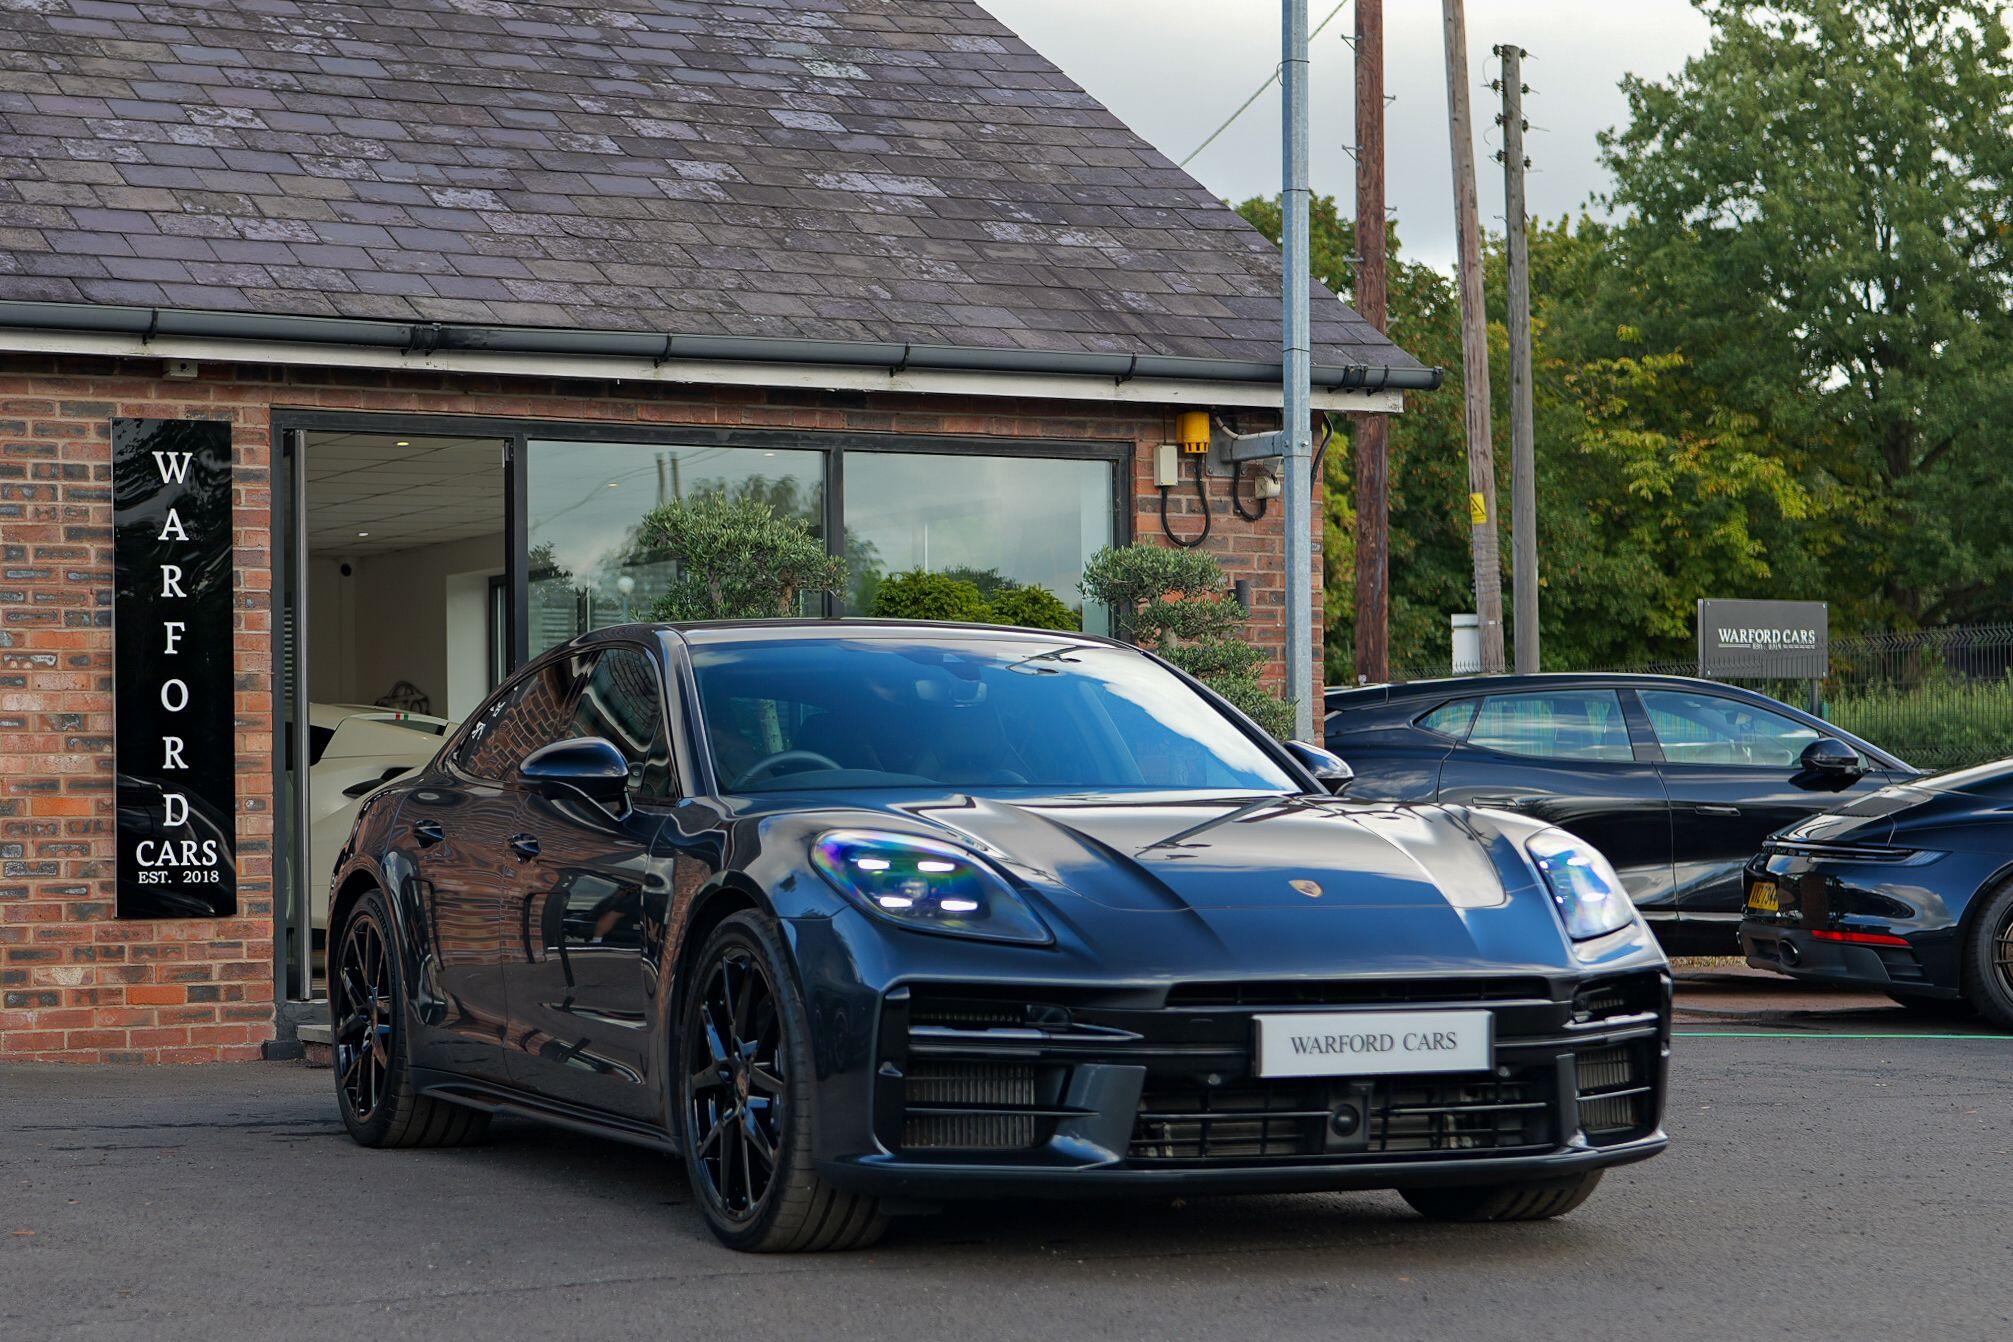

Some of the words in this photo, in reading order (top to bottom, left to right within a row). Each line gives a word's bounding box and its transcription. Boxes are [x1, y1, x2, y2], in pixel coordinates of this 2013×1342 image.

[151, 451, 193, 827] WARFORD
[1718, 628, 1781, 643] WARFORD
[1782, 629, 1816, 644] CARS
[136, 839, 218, 867] CARS
[138, 871, 172, 884] EST.
[182, 870, 220, 883] 2018
[1290, 1033, 1394, 1055] WARFORD
[1402, 1031, 1457, 1052] CARS
